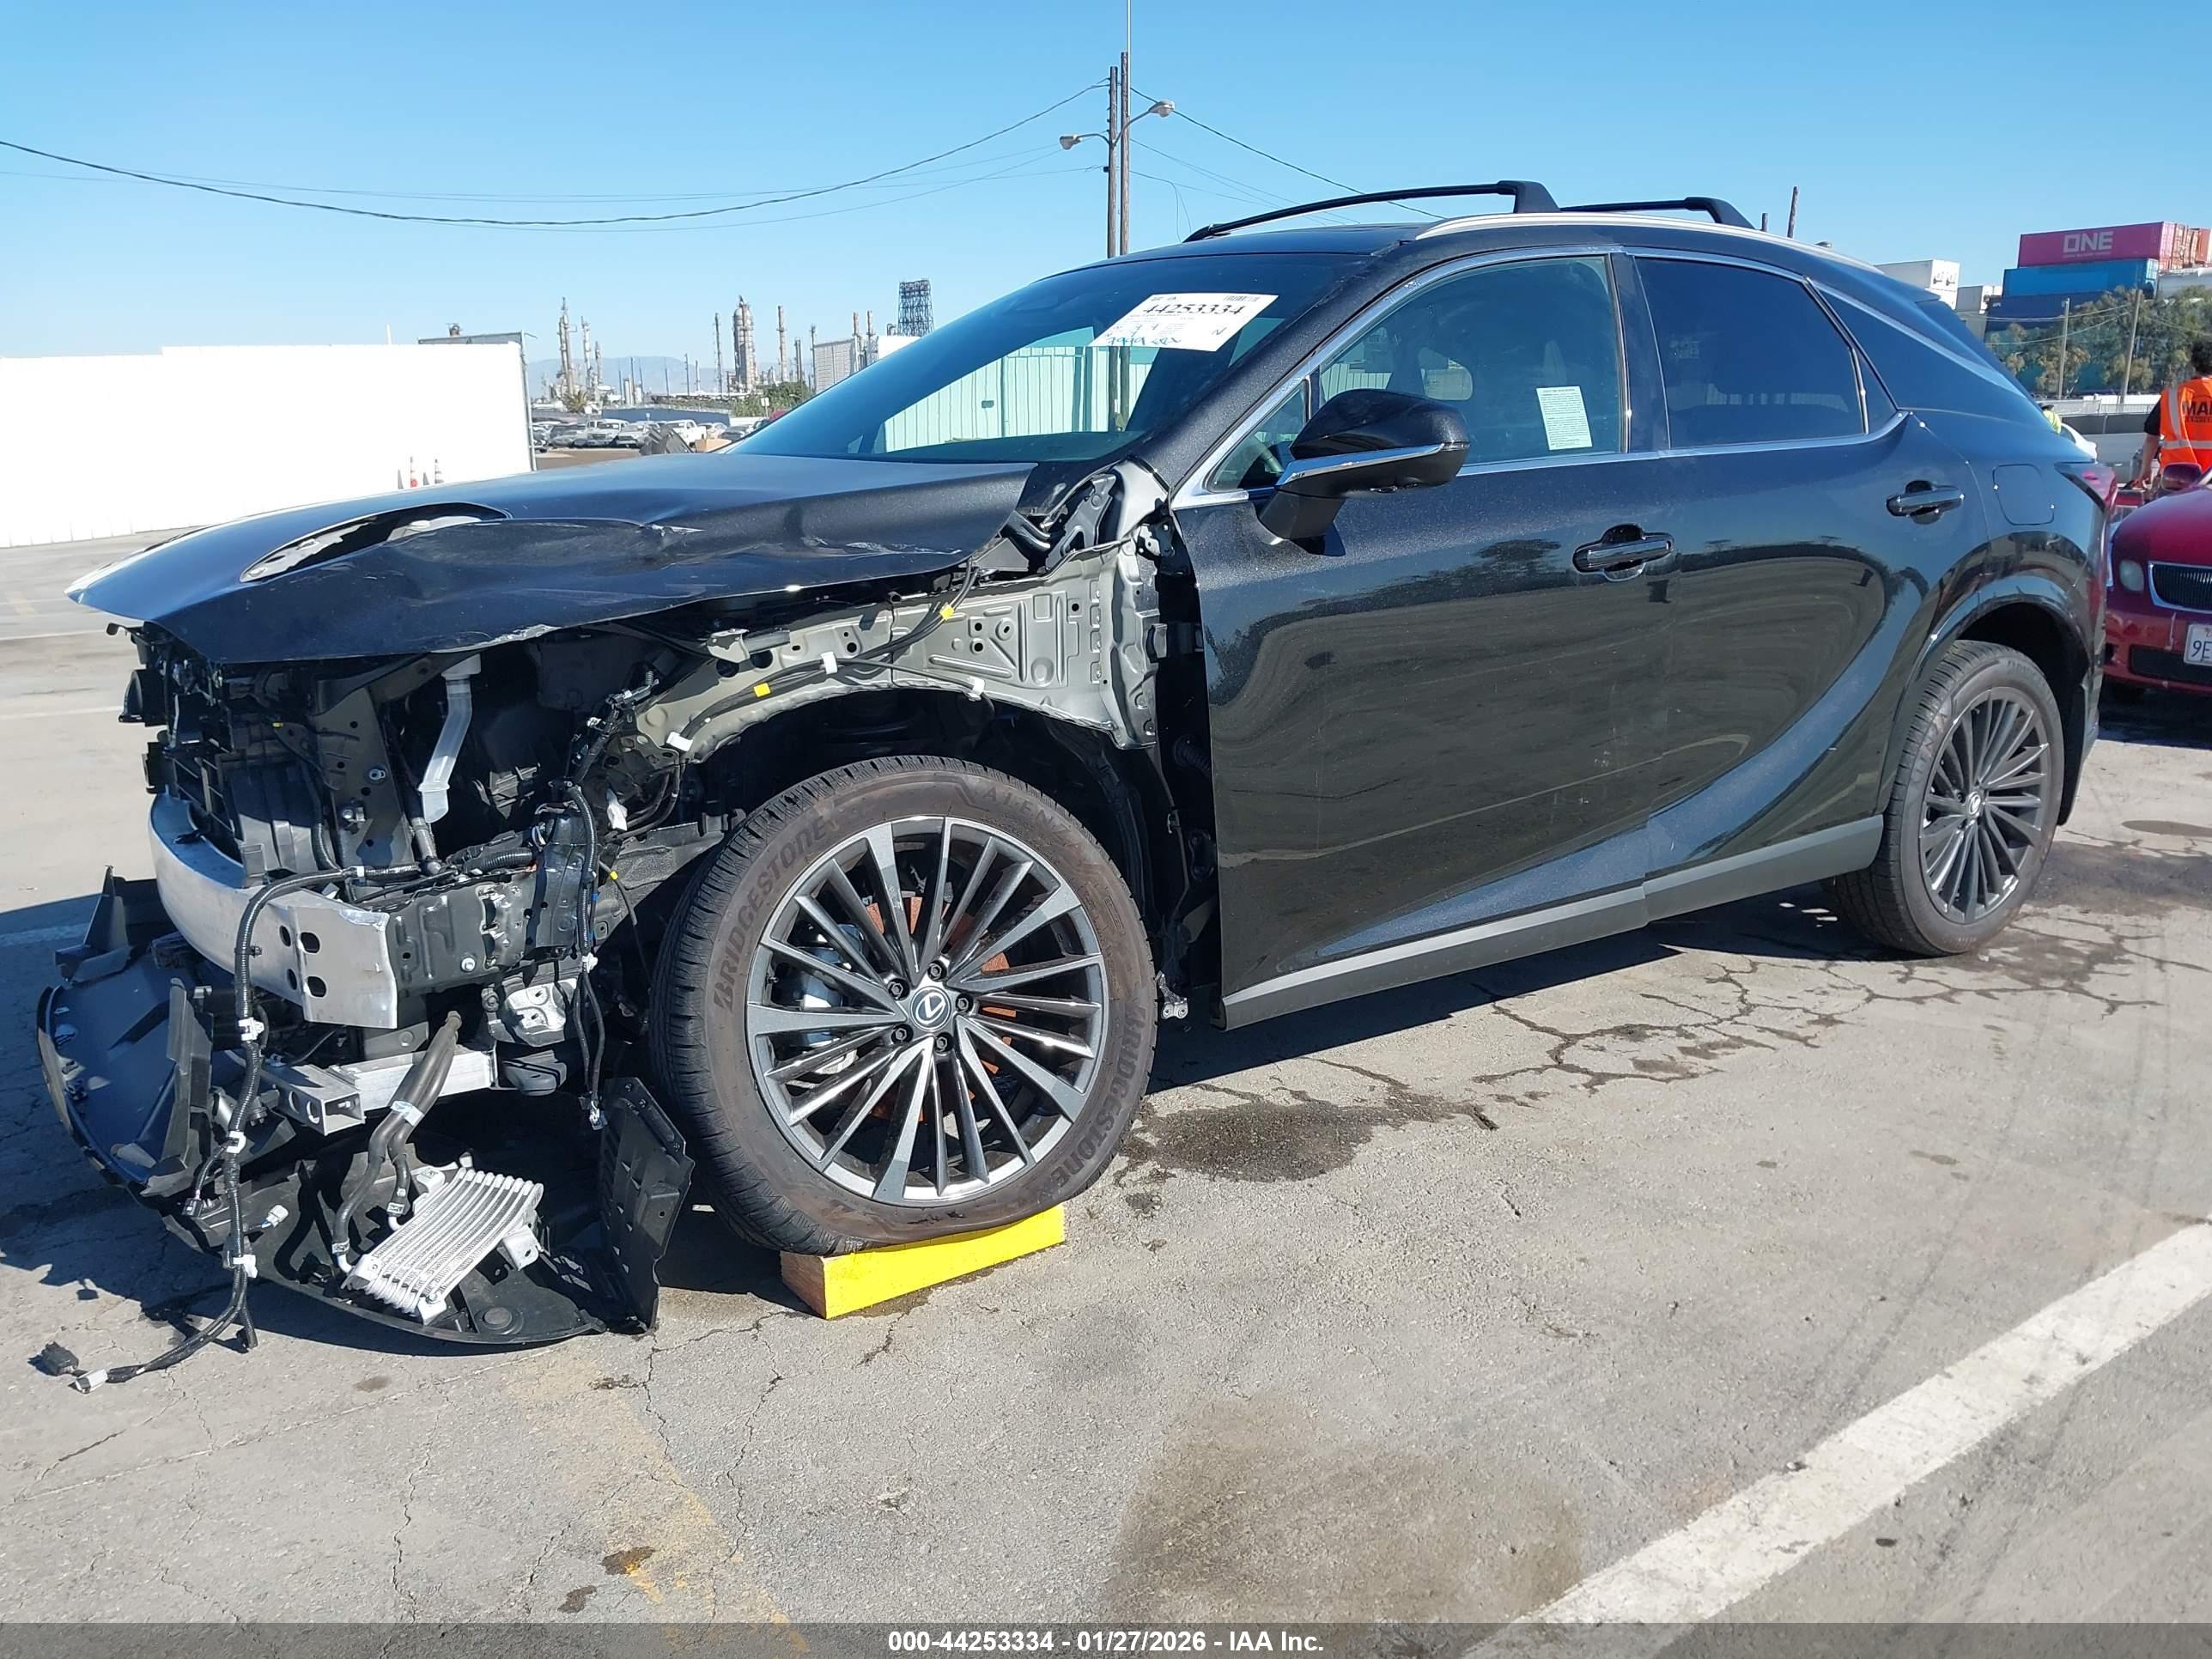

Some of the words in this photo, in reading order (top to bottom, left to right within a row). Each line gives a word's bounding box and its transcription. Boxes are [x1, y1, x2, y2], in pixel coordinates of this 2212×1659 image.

[2063, 231, 2114, 252] ONE
[1143, 303, 1245, 314] 44253334
[2182, 400, 2212, 416] MA
[714, 820, 827, 1012] BRIDGESTONE
[1051, 1005, 1146, 1188] BRIDGESTONE
